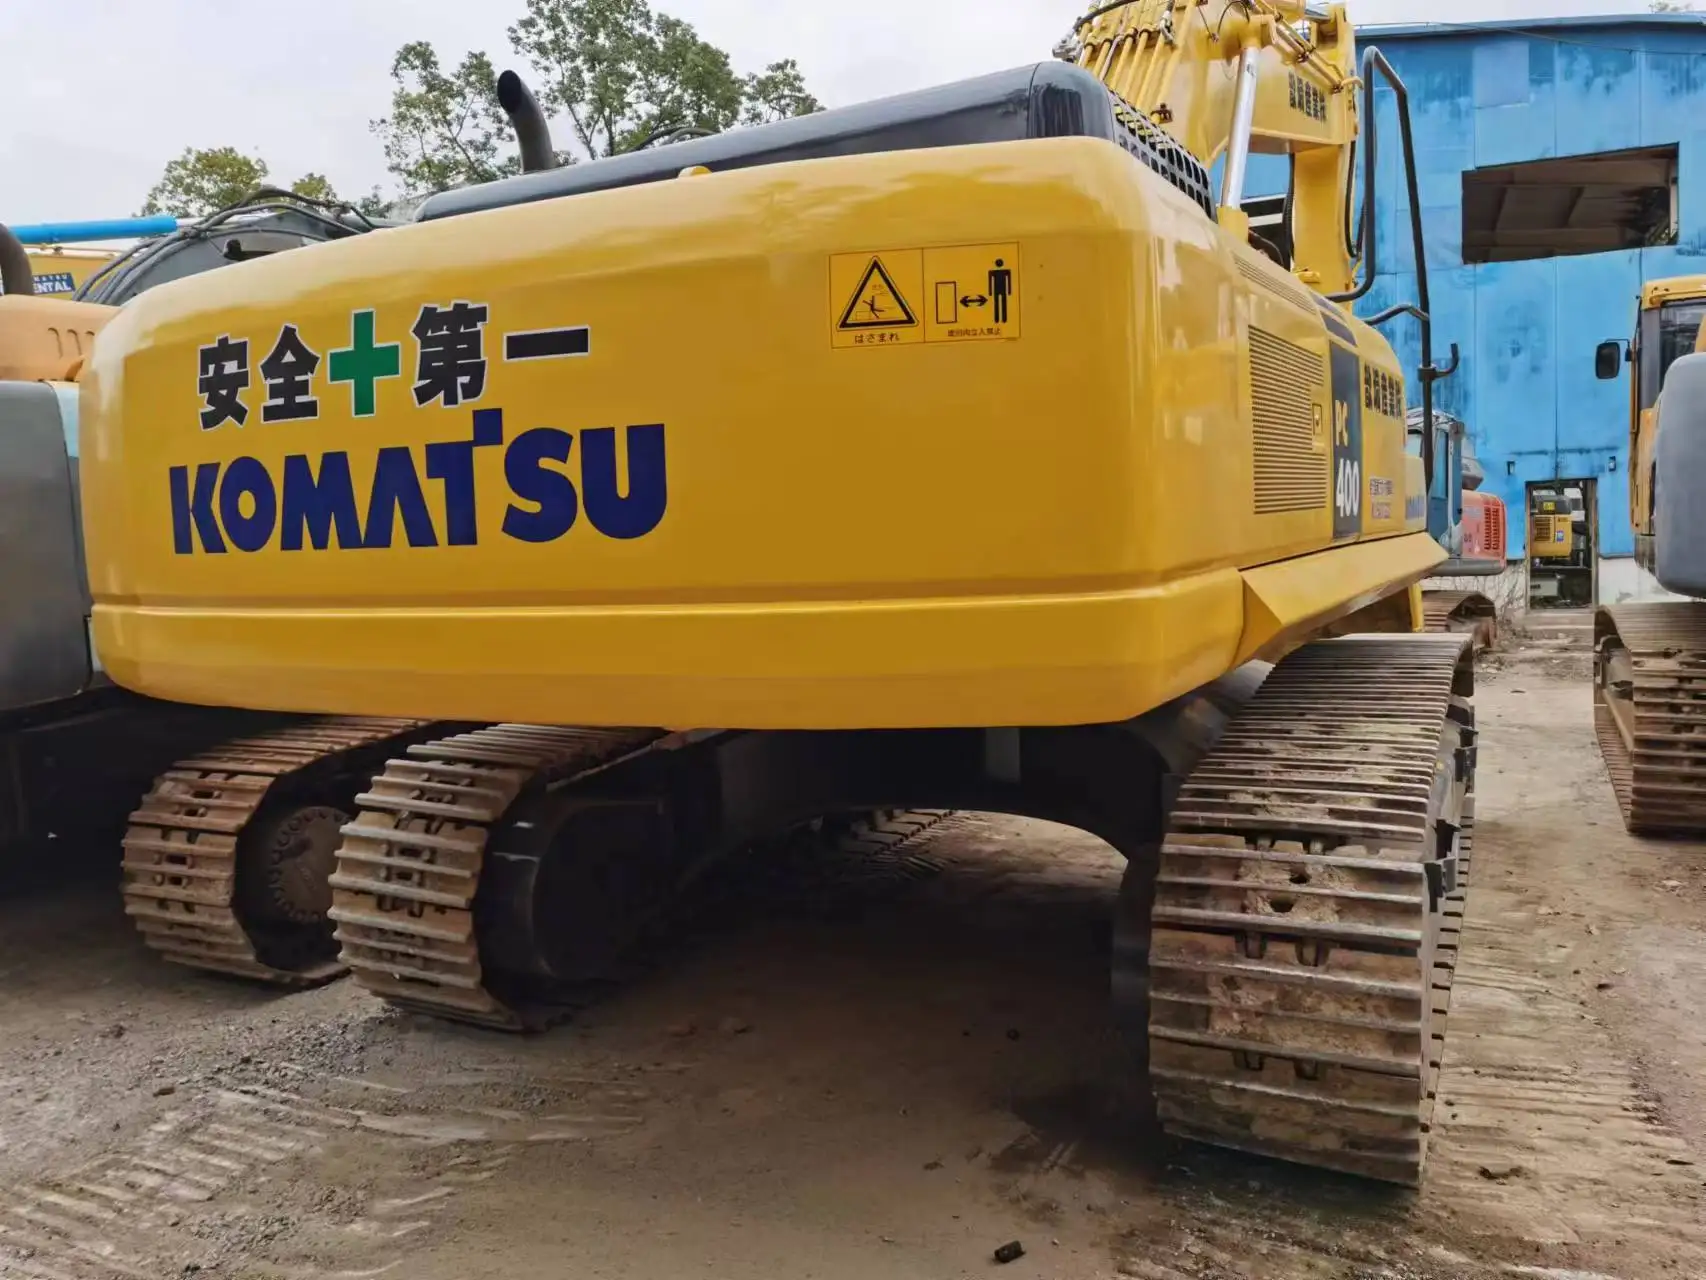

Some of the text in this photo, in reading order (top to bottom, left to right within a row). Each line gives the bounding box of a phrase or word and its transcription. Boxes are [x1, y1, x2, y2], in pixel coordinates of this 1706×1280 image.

[854, 331, 900, 344] はさまれ
[1335, 399, 1348, 447] PC
[169, 408, 668, 555] KOMATSU
[1336, 457, 1360, 518] 400
